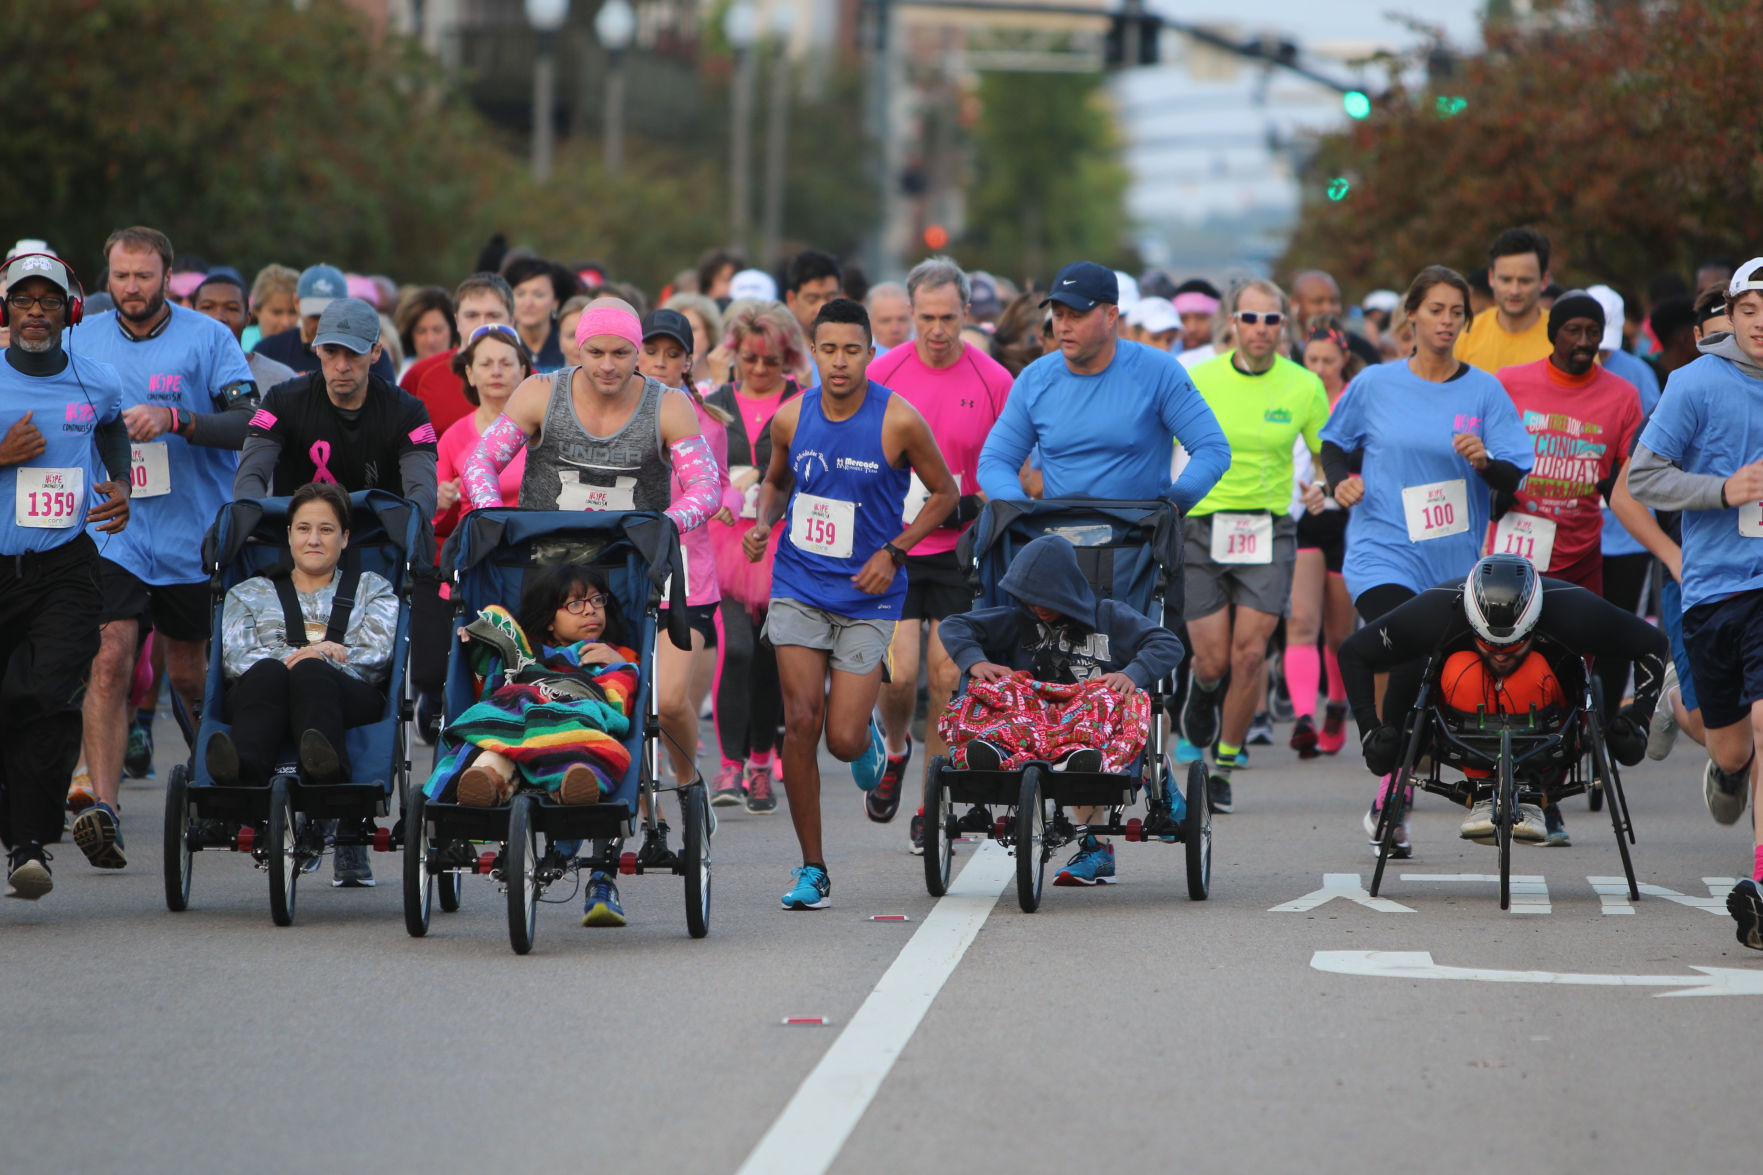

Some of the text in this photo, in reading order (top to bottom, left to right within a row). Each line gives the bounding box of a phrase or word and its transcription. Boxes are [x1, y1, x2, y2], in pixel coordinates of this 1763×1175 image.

[149, 373, 182, 392] HOPE
[65, 401, 97, 423] HOPE
[559, 441, 642, 465] UNDER
[844, 457, 879, 470] Mercado
[28, 491, 76, 517] 1359
[1421, 503, 1455, 530] 100
[806, 517, 836, 546] 159
[1226, 534, 1257, 555] 130
[1503, 533, 1535, 560] 111
